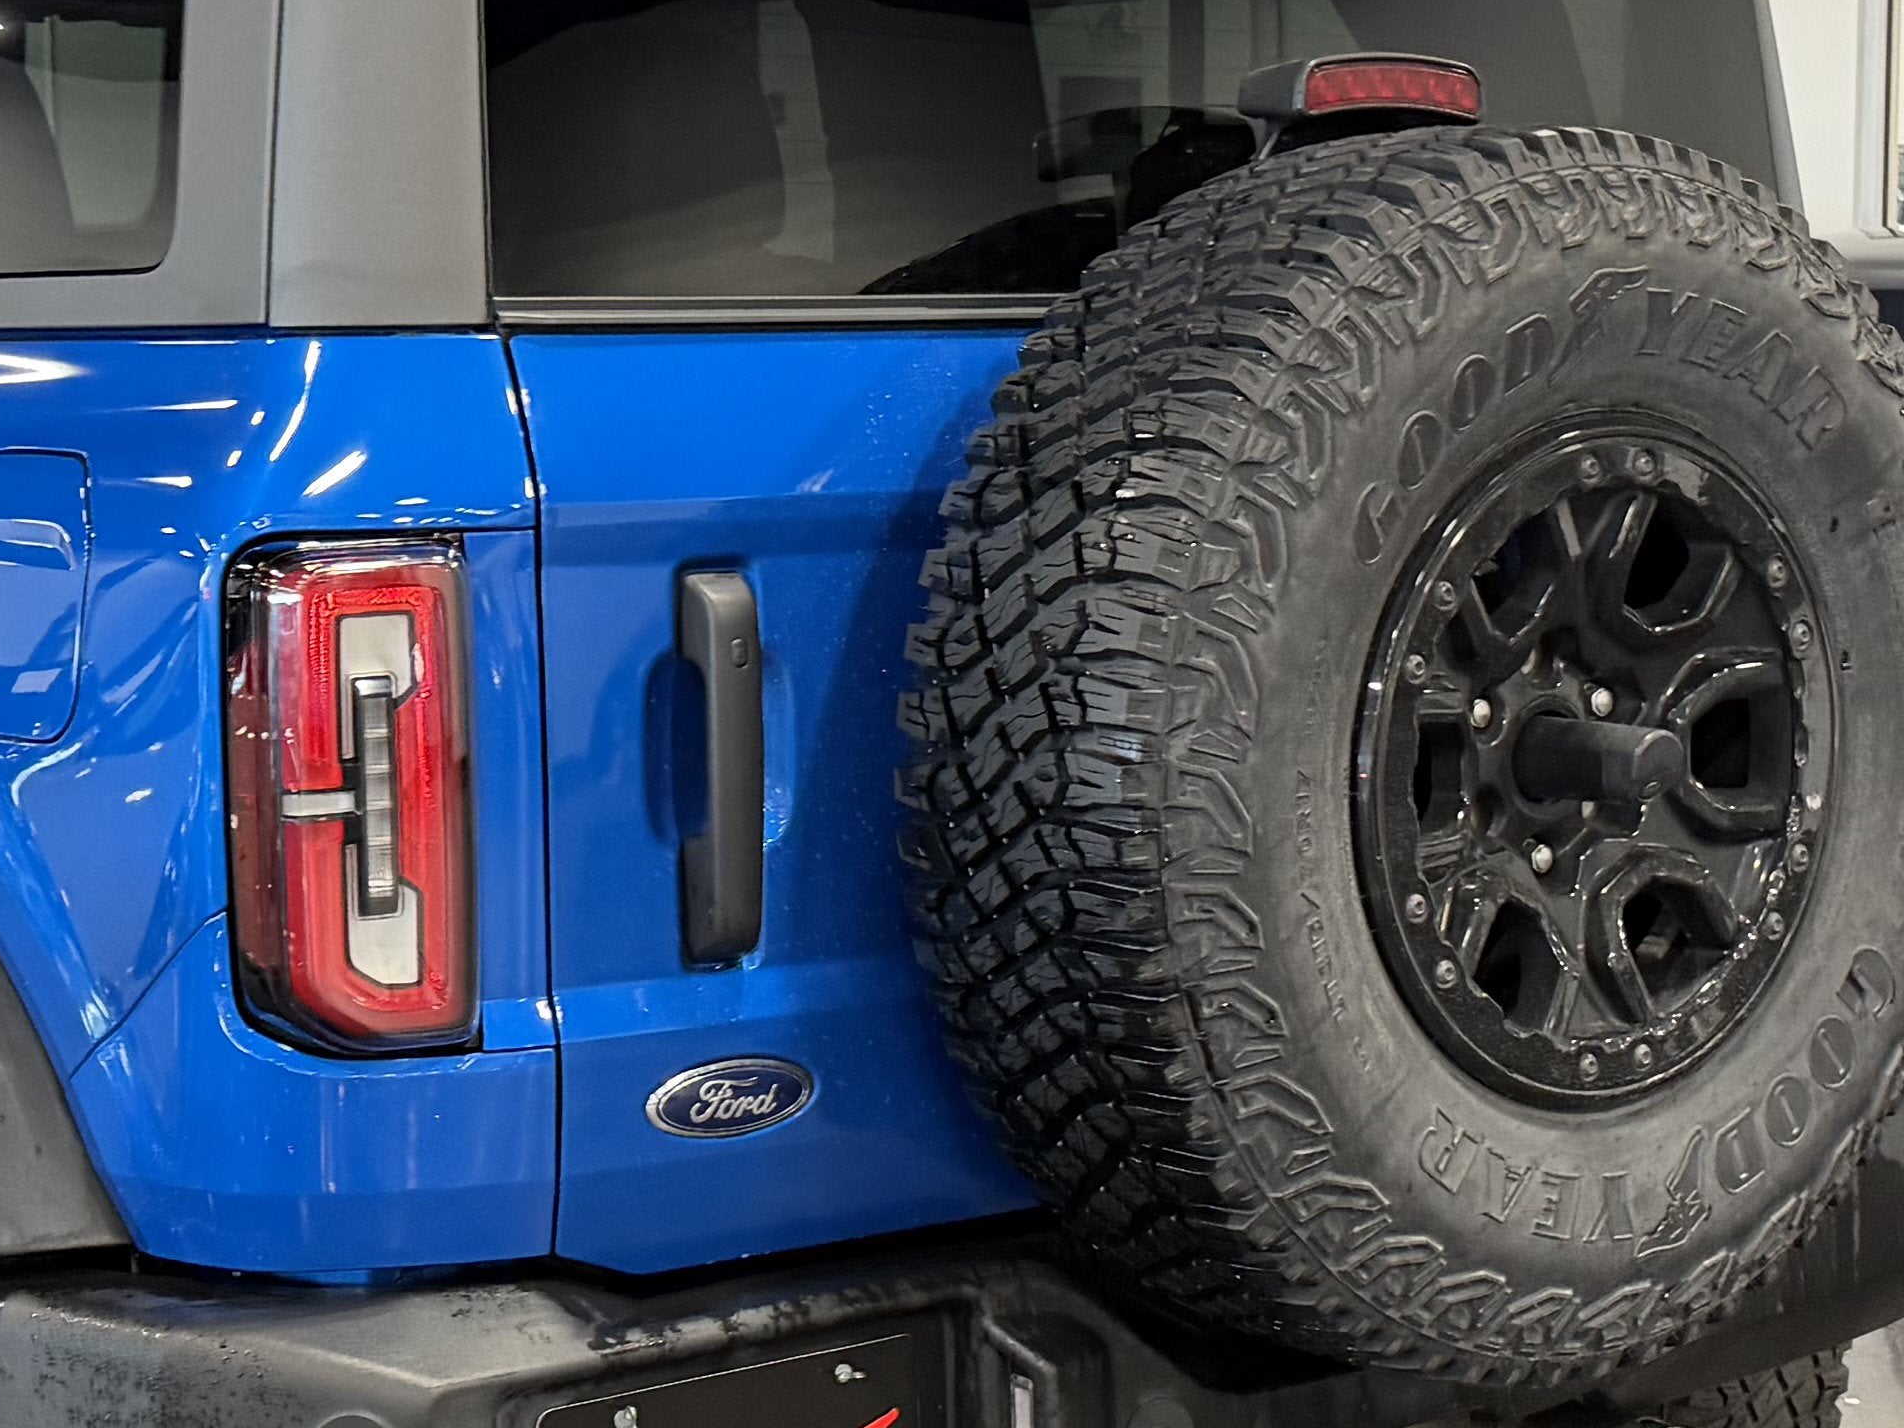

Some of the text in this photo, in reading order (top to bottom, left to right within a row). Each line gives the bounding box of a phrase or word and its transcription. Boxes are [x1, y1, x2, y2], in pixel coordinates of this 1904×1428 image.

[1352, 264, 1848, 565] GOODYEAR
[689, 1076, 779, 1123] Ford
[1418, 944, 1895, 1259] GOODYEAR
